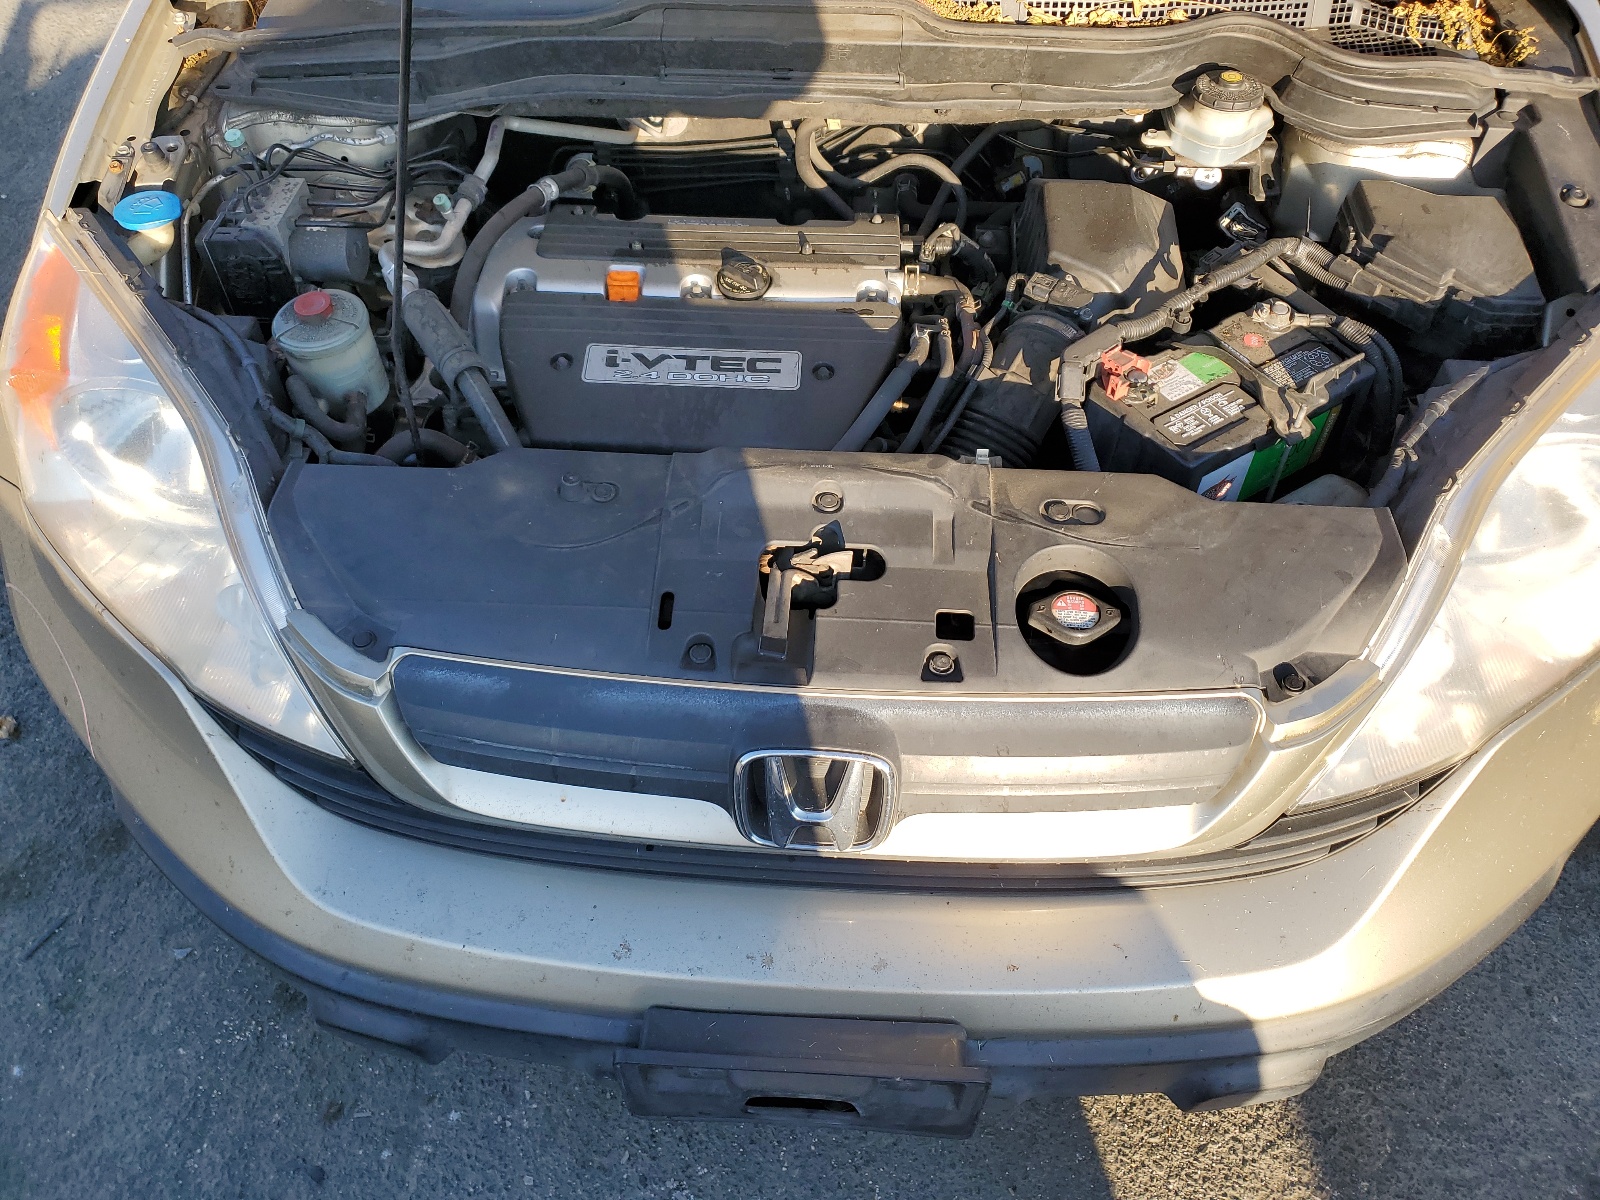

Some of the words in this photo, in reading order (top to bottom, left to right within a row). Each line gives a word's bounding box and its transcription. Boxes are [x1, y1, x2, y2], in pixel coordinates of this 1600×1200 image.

[605, 349, 782, 374] i-VTEC
[613, 369, 660, 380] 2.4
[667, 371, 771, 384] DOHC
